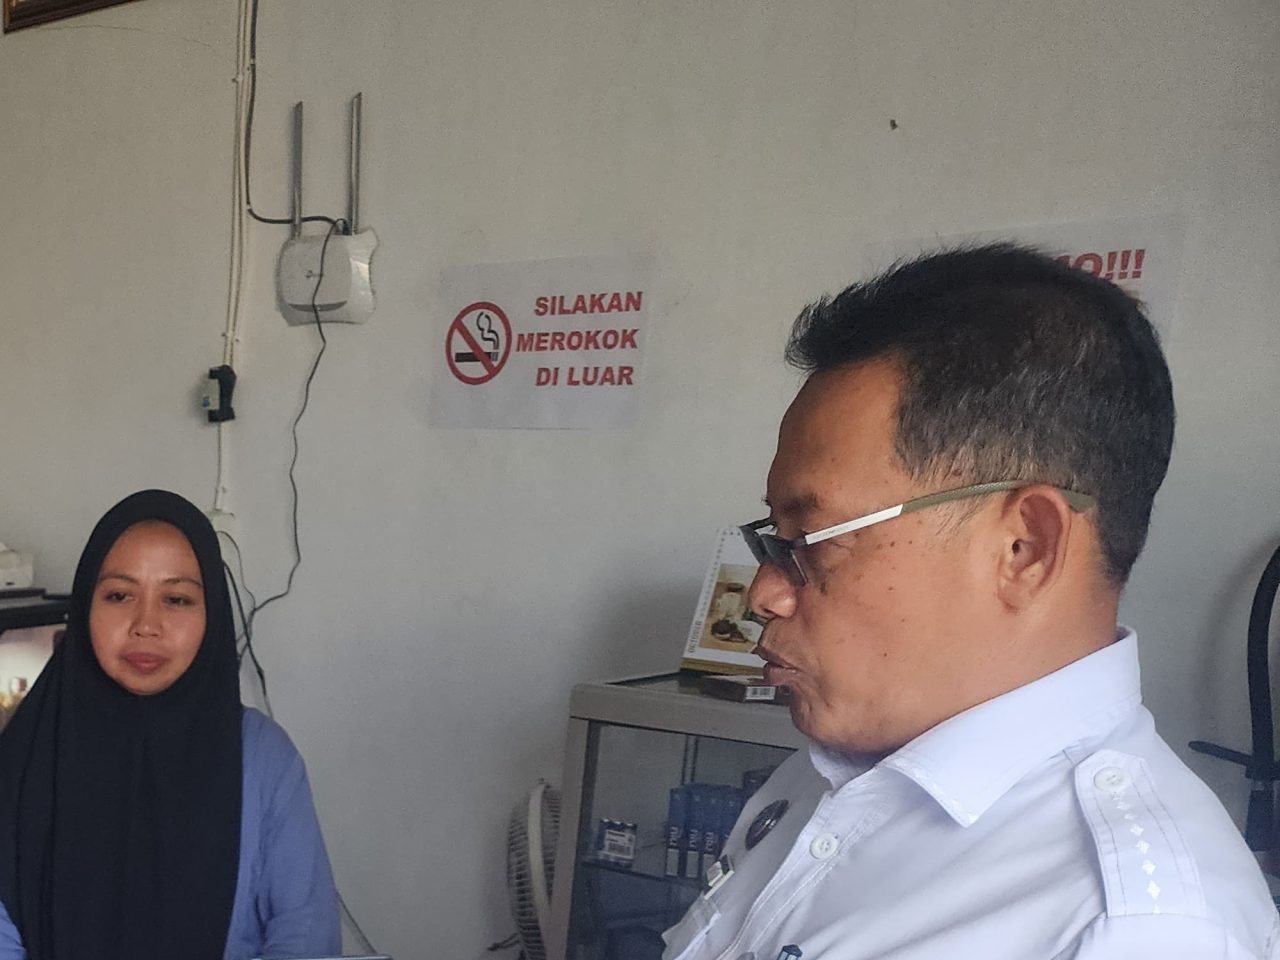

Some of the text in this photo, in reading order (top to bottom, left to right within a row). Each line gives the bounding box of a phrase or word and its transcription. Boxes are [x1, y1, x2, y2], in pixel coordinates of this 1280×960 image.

[1054, 248, 1146, 281] O!!!
[534, 291, 643, 316] SILAKAN
[516, 328, 640, 352] MEROKOK
[535, 366, 634, 386] DI LUAR
